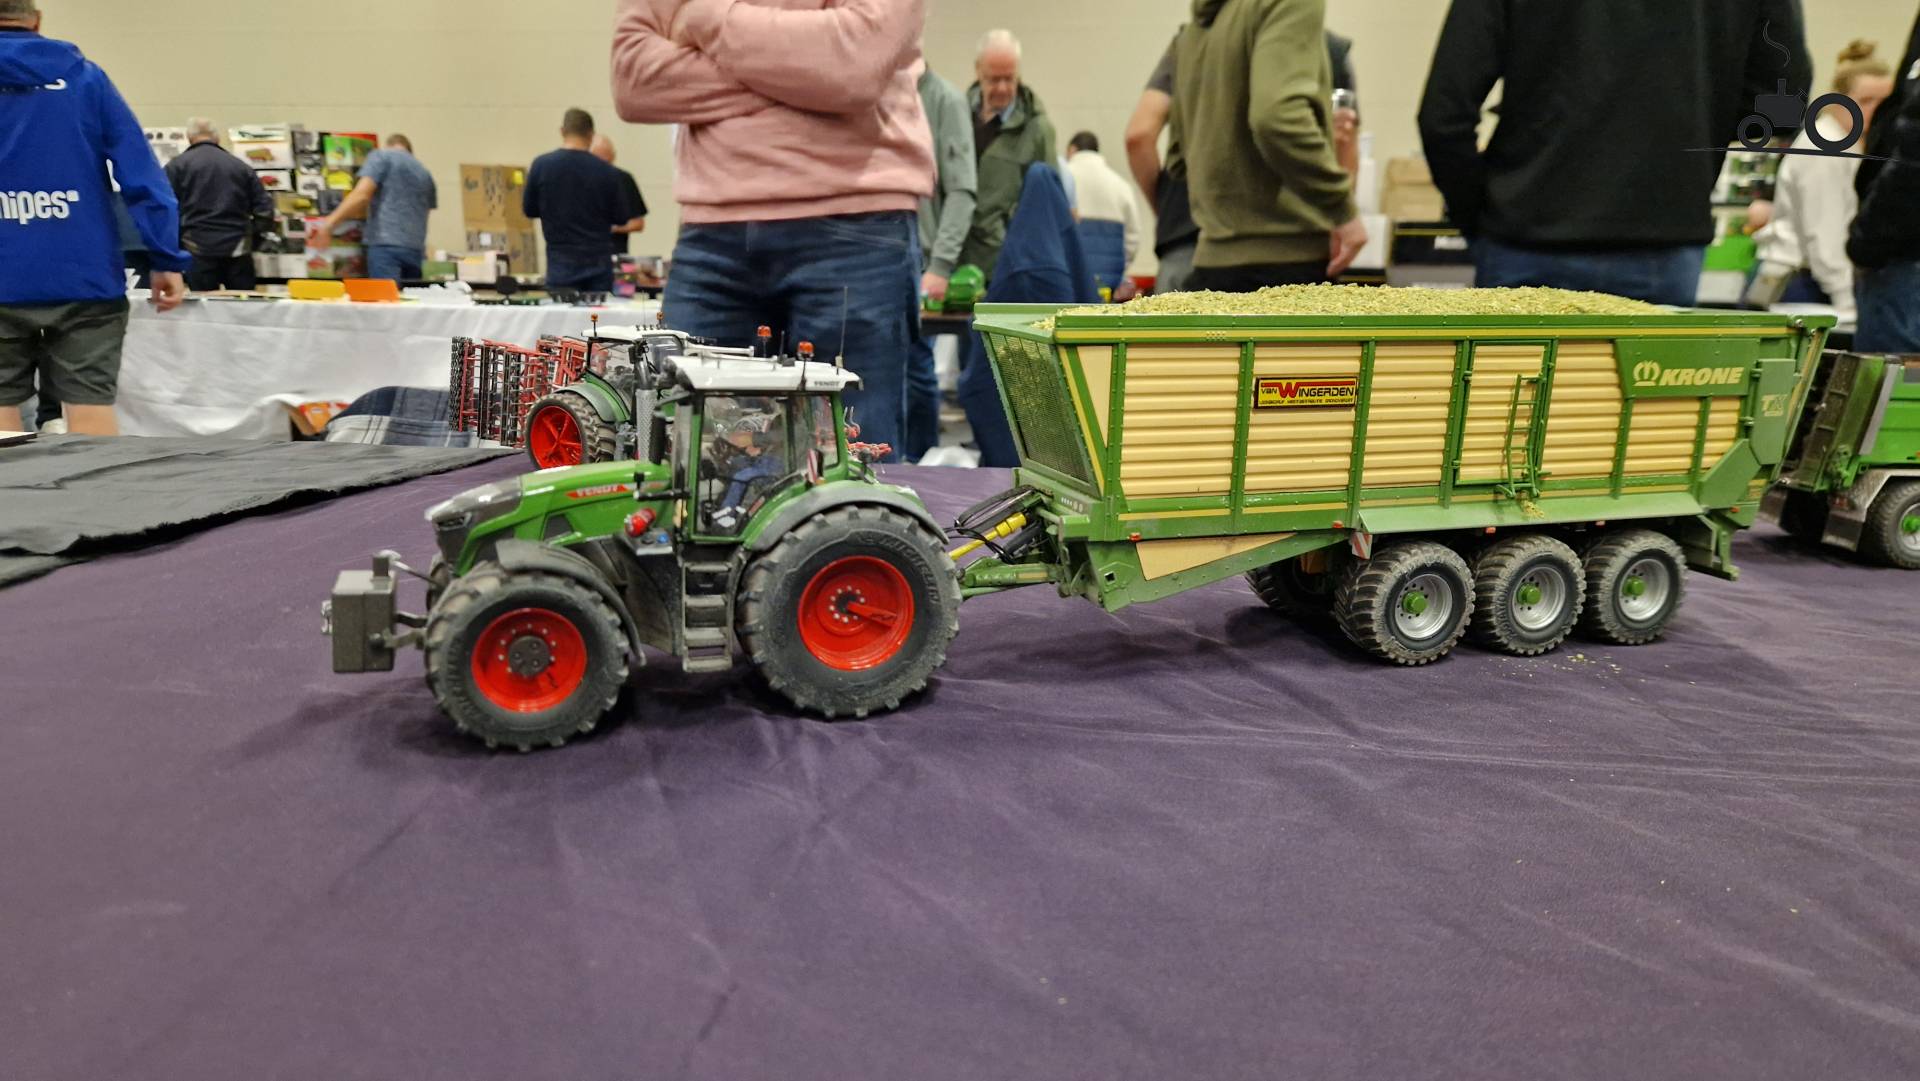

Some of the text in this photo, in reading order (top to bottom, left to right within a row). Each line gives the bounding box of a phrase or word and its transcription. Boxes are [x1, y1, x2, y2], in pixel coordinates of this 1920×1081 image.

[1658, 367, 1745, 386] KRONE
[1279, 382, 1355, 398] WINGERDEN
[576, 483, 620, 498] FENDT
